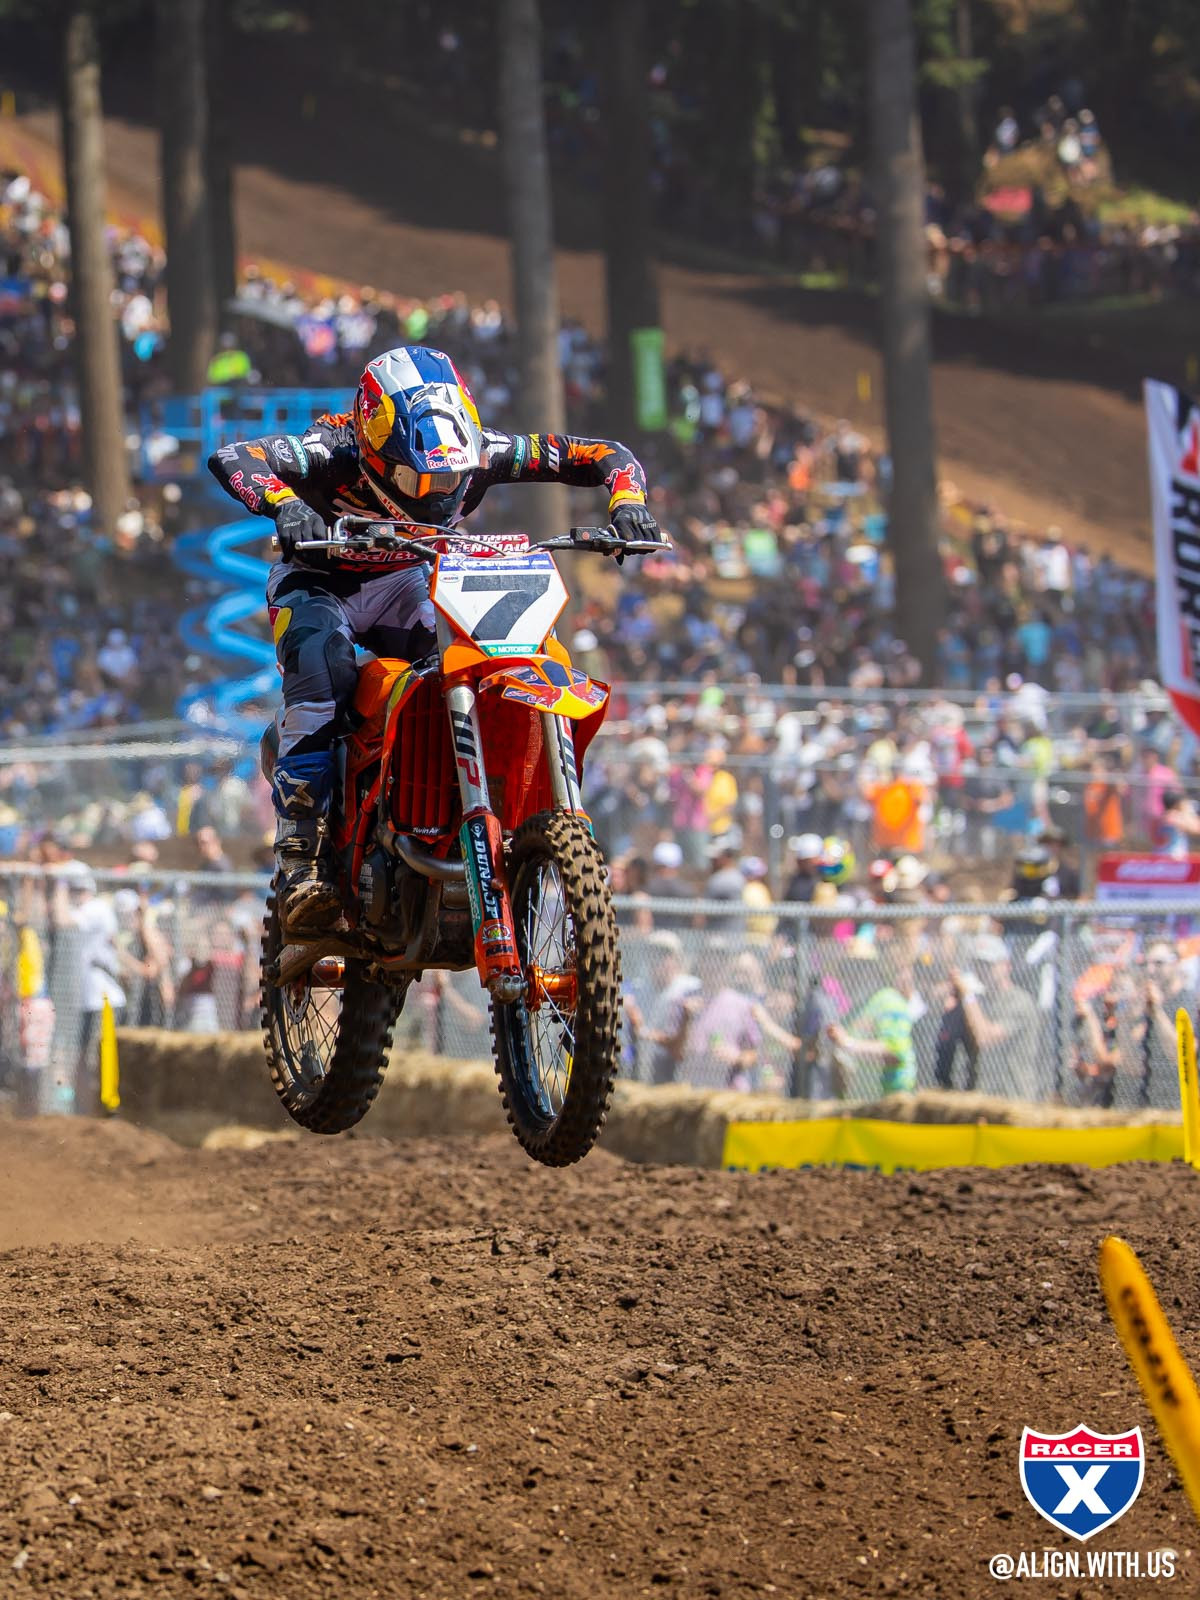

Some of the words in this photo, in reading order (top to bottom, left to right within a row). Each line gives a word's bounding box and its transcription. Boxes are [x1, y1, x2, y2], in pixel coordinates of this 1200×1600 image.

[427, 459, 449, 469] Red
[450, 456, 469, 466] Bull
[229, 470, 252, 498] Red
[461, 574, 551, 641] 7
